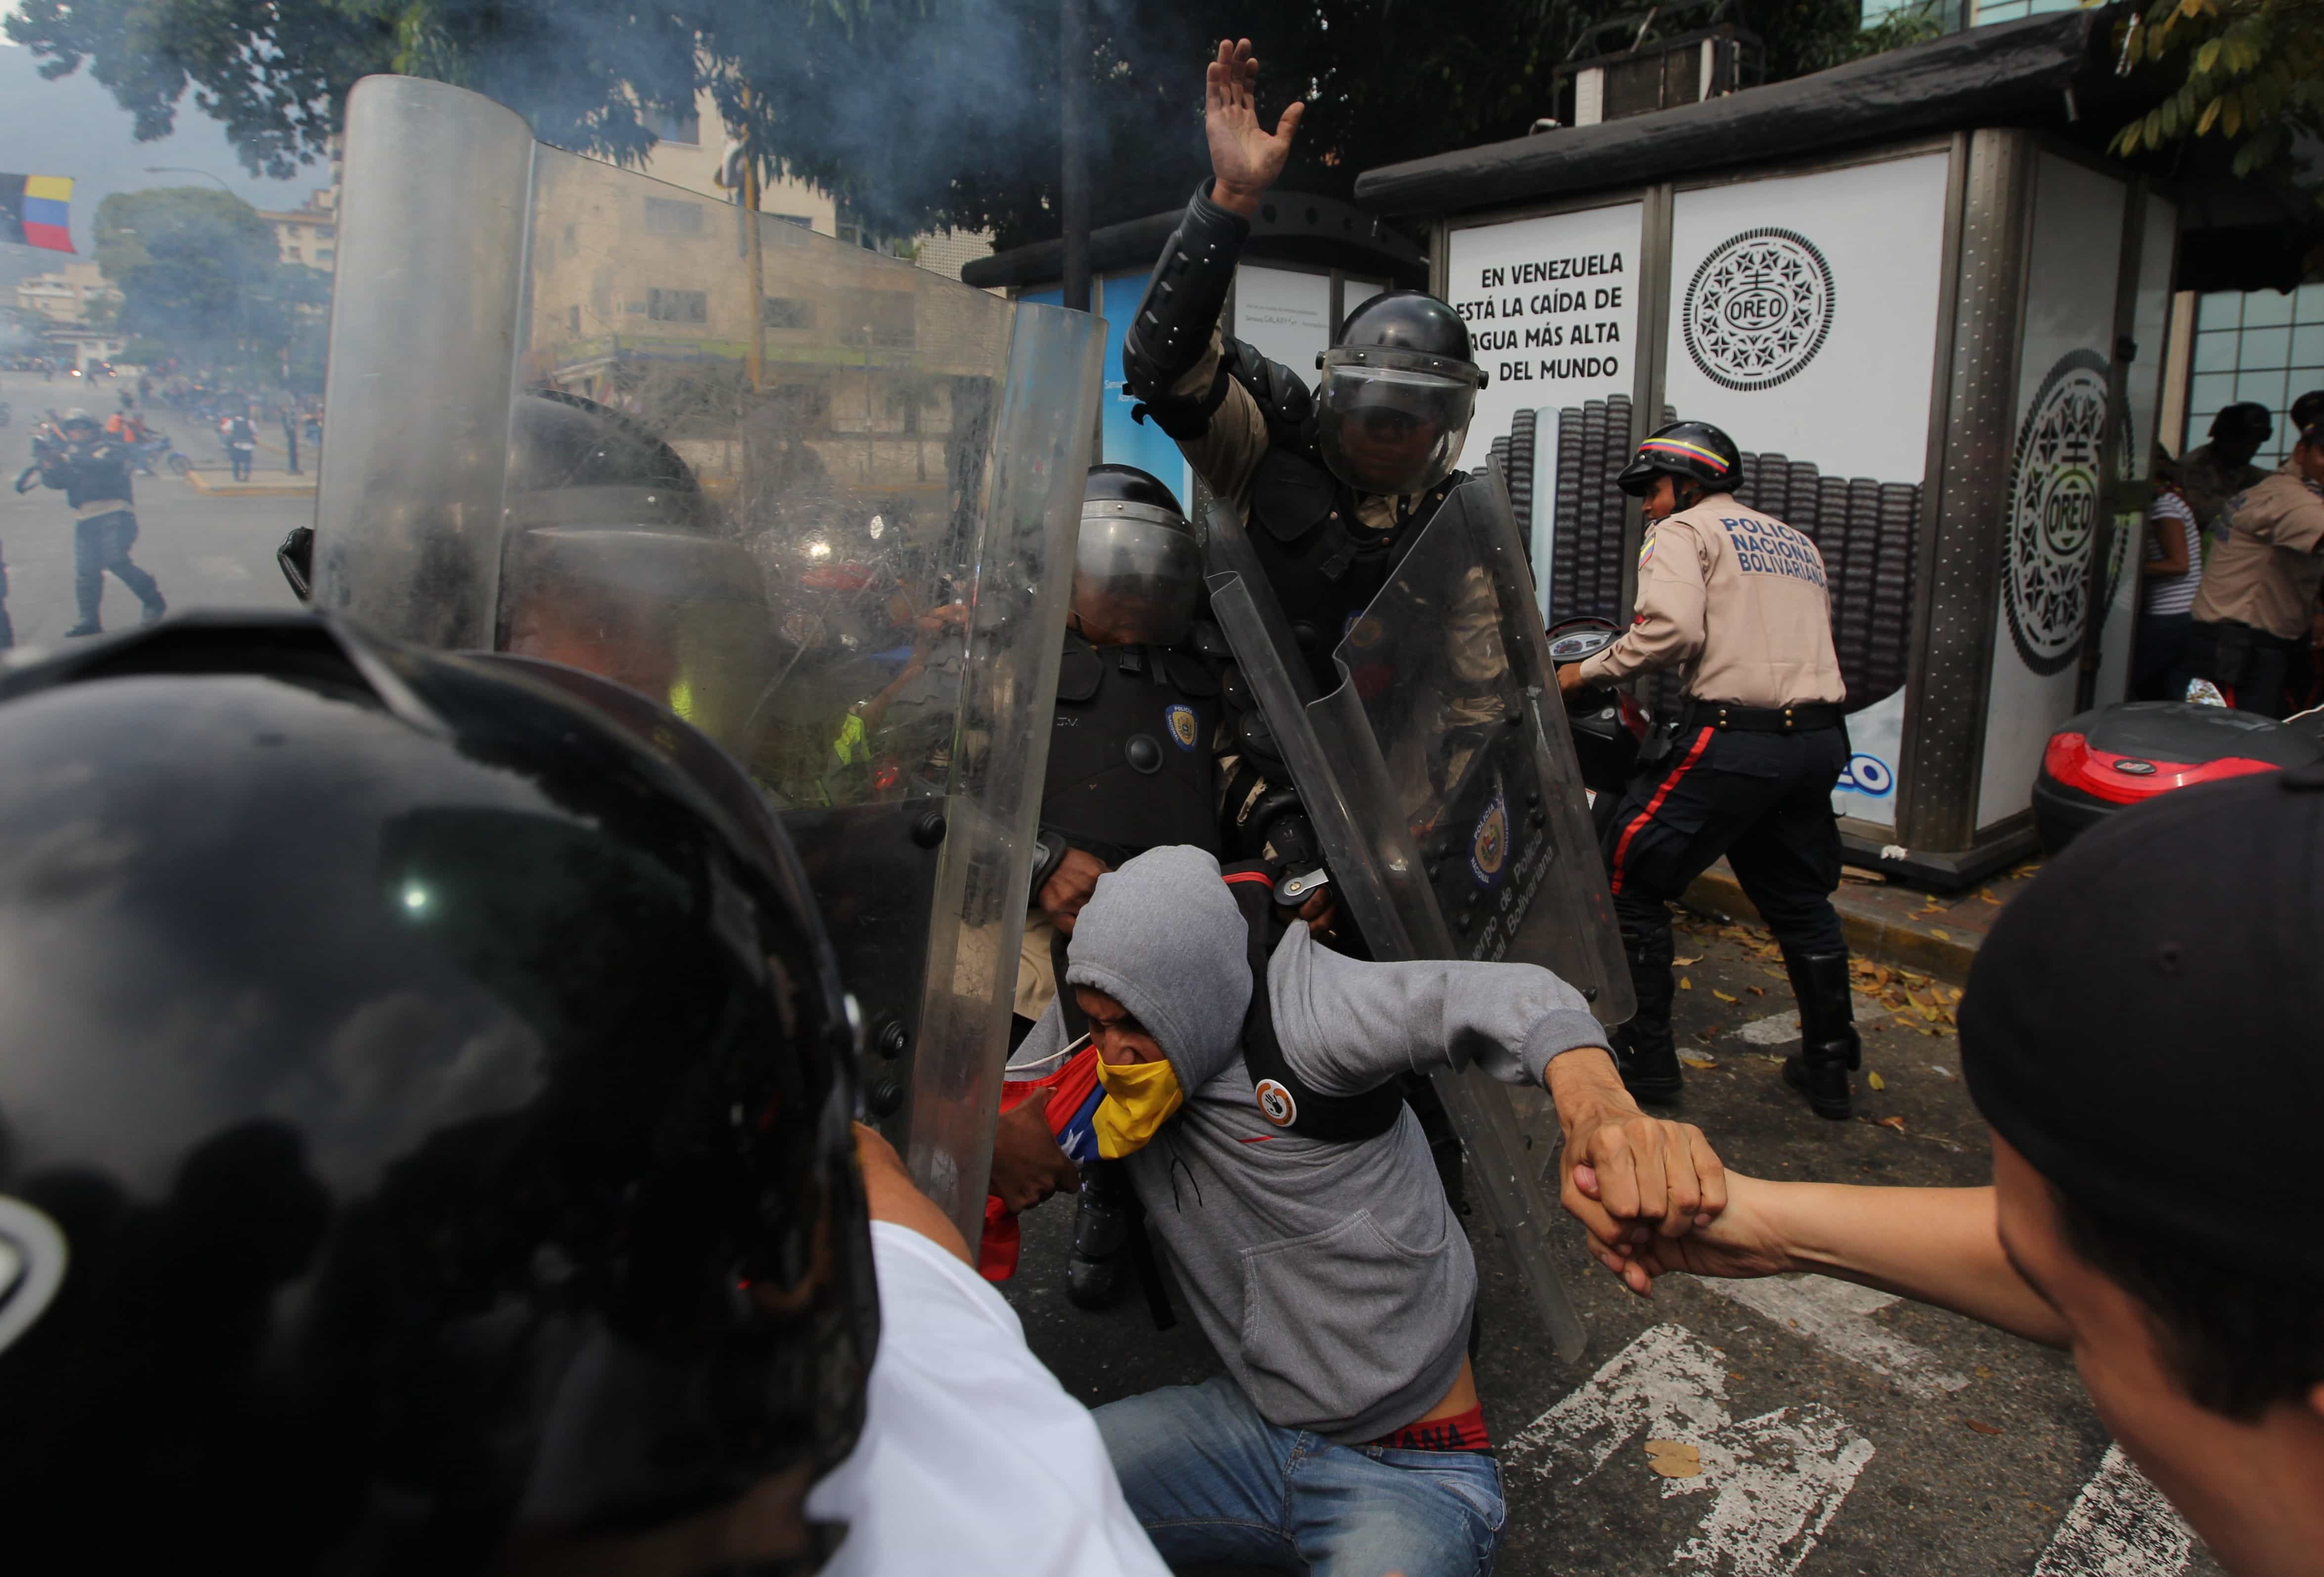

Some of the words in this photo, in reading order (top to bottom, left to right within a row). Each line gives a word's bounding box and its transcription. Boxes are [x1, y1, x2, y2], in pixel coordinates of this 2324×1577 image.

[1482, 267, 1504, 288] EN
[1512, 252, 1623, 284] VENEZUELA
[1456, 295, 1495, 320] ESTÁ
[1503, 298, 1523, 317] LA
[1531, 288, 1586, 314] CAÍDA
[1595, 287, 1622, 309] DE
[1731, 298, 1781, 320] OREO
[1525, 322, 1563, 348] MÁS
[1570, 322, 1620, 345] ALTA
[1500, 361, 1533, 381] DEL
[1540, 356, 1618, 379] MUNDO
[2049, 492, 2092, 534] OREO
[1730, 534, 1822, 569] NACIONAL
[1167, 714, 1180, 741] NACIONAL
[1500, 887, 1512, 912] de
[1508, 845, 1554, 936] Bolivariana
